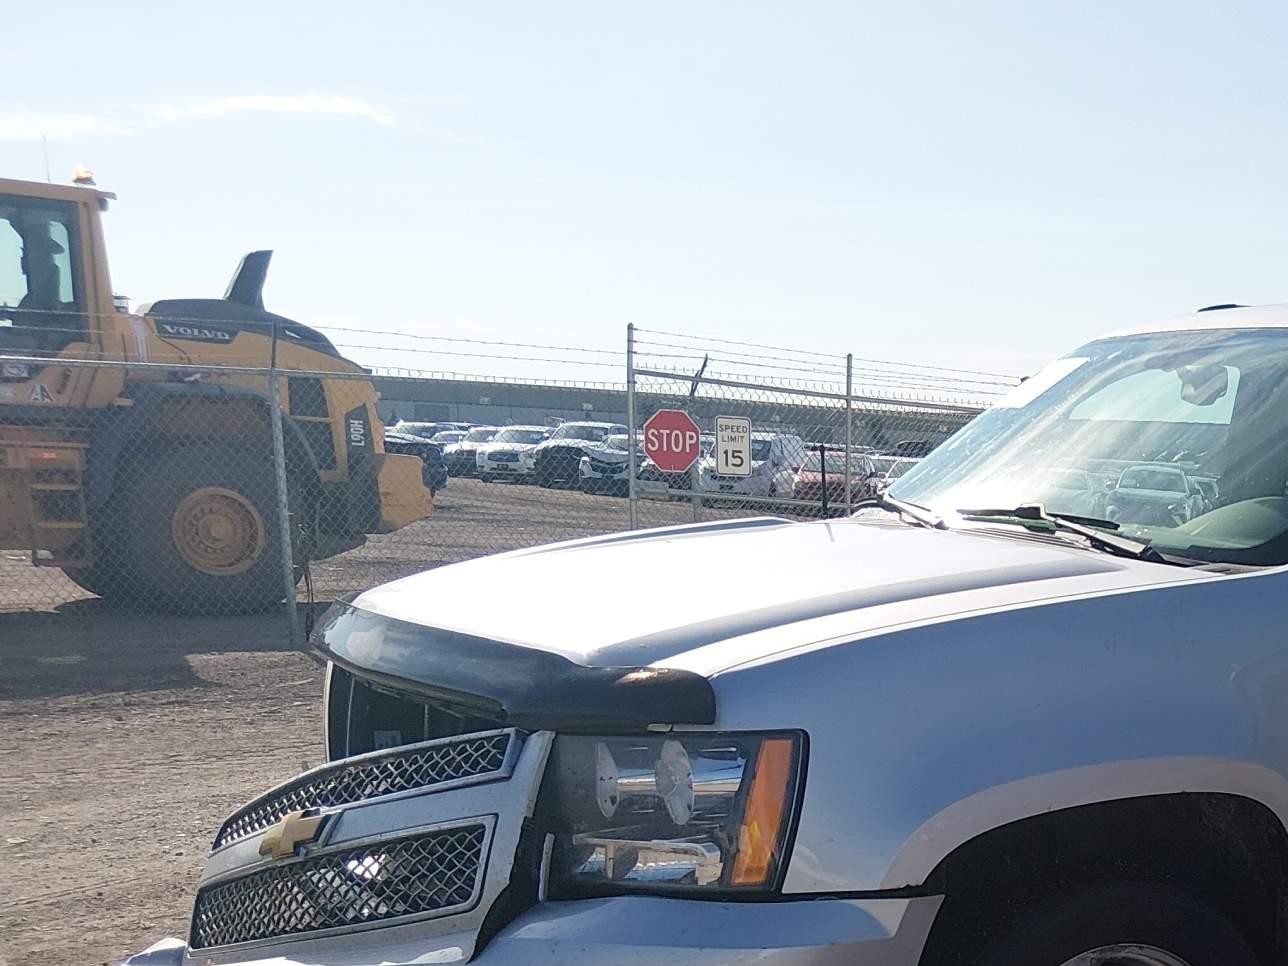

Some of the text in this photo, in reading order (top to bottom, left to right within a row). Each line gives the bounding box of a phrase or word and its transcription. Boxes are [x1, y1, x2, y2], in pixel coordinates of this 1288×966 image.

[162, 324, 230, 340] VOLVO
[350, 420, 366, 446] L90H
[719, 424, 748, 434] SPEED
[647, 428, 697, 453] STOP
[721, 435, 745, 443] LIMIT
[723, 449, 744, 467] 15
